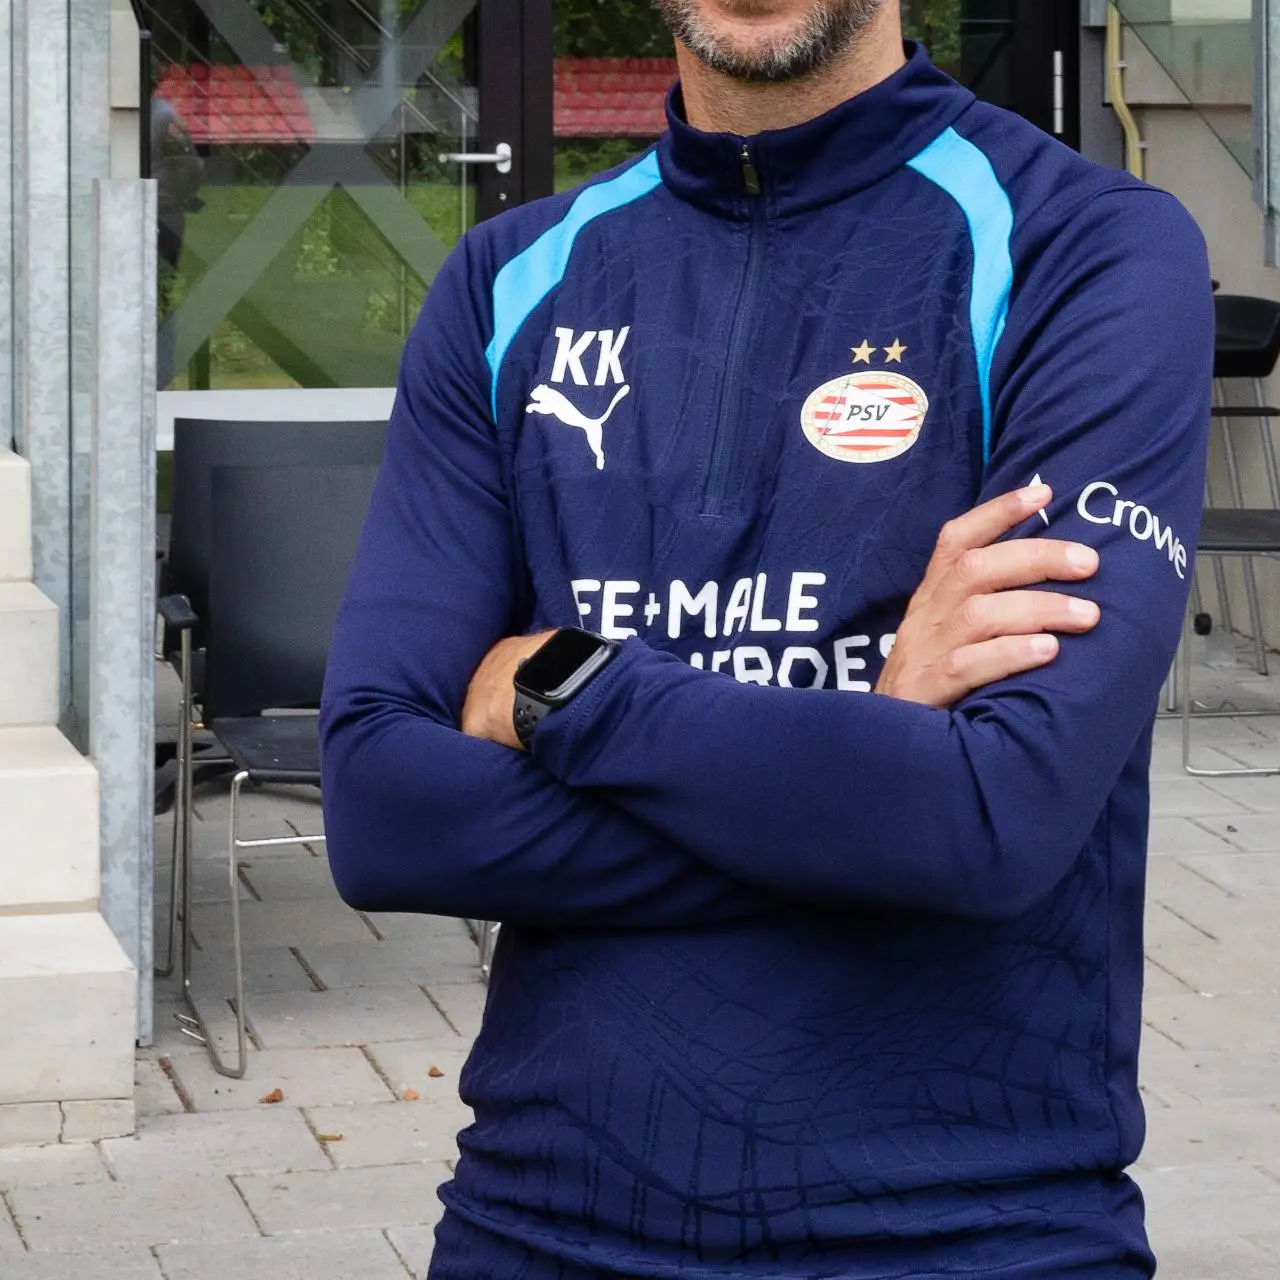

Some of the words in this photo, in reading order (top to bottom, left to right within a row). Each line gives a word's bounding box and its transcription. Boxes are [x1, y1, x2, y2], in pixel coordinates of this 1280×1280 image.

[550, 325, 631, 386] KK
[846, 404, 891, 421] PSV
[1076, 481, 1187, 580] Crowe
